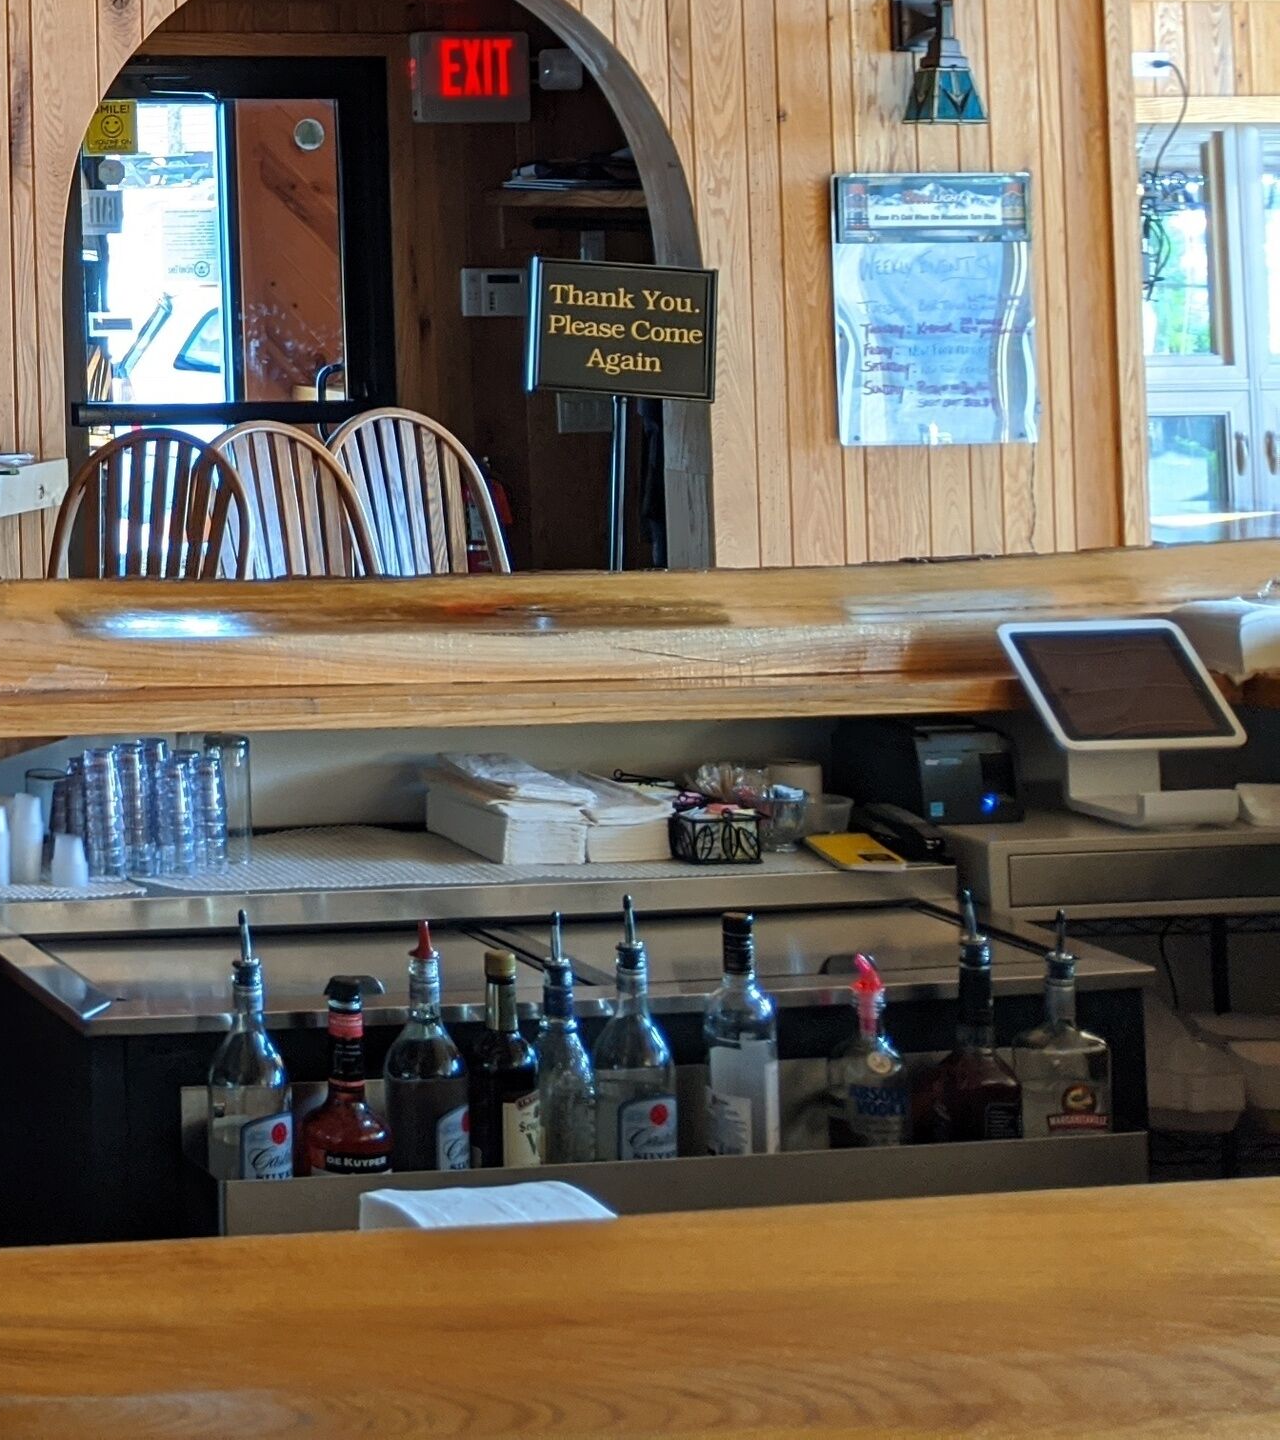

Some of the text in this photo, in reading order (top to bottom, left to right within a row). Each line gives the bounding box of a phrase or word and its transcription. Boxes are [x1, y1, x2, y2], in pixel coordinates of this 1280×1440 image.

[442, 38, 513, 97] EXIT
[549, 283, 700, 314] Thank You.
[548, 314, 703, 344] Please Come
[586, 348, 661, 375] Again
[326, 1155, 387, 1167] DE KUYPER
